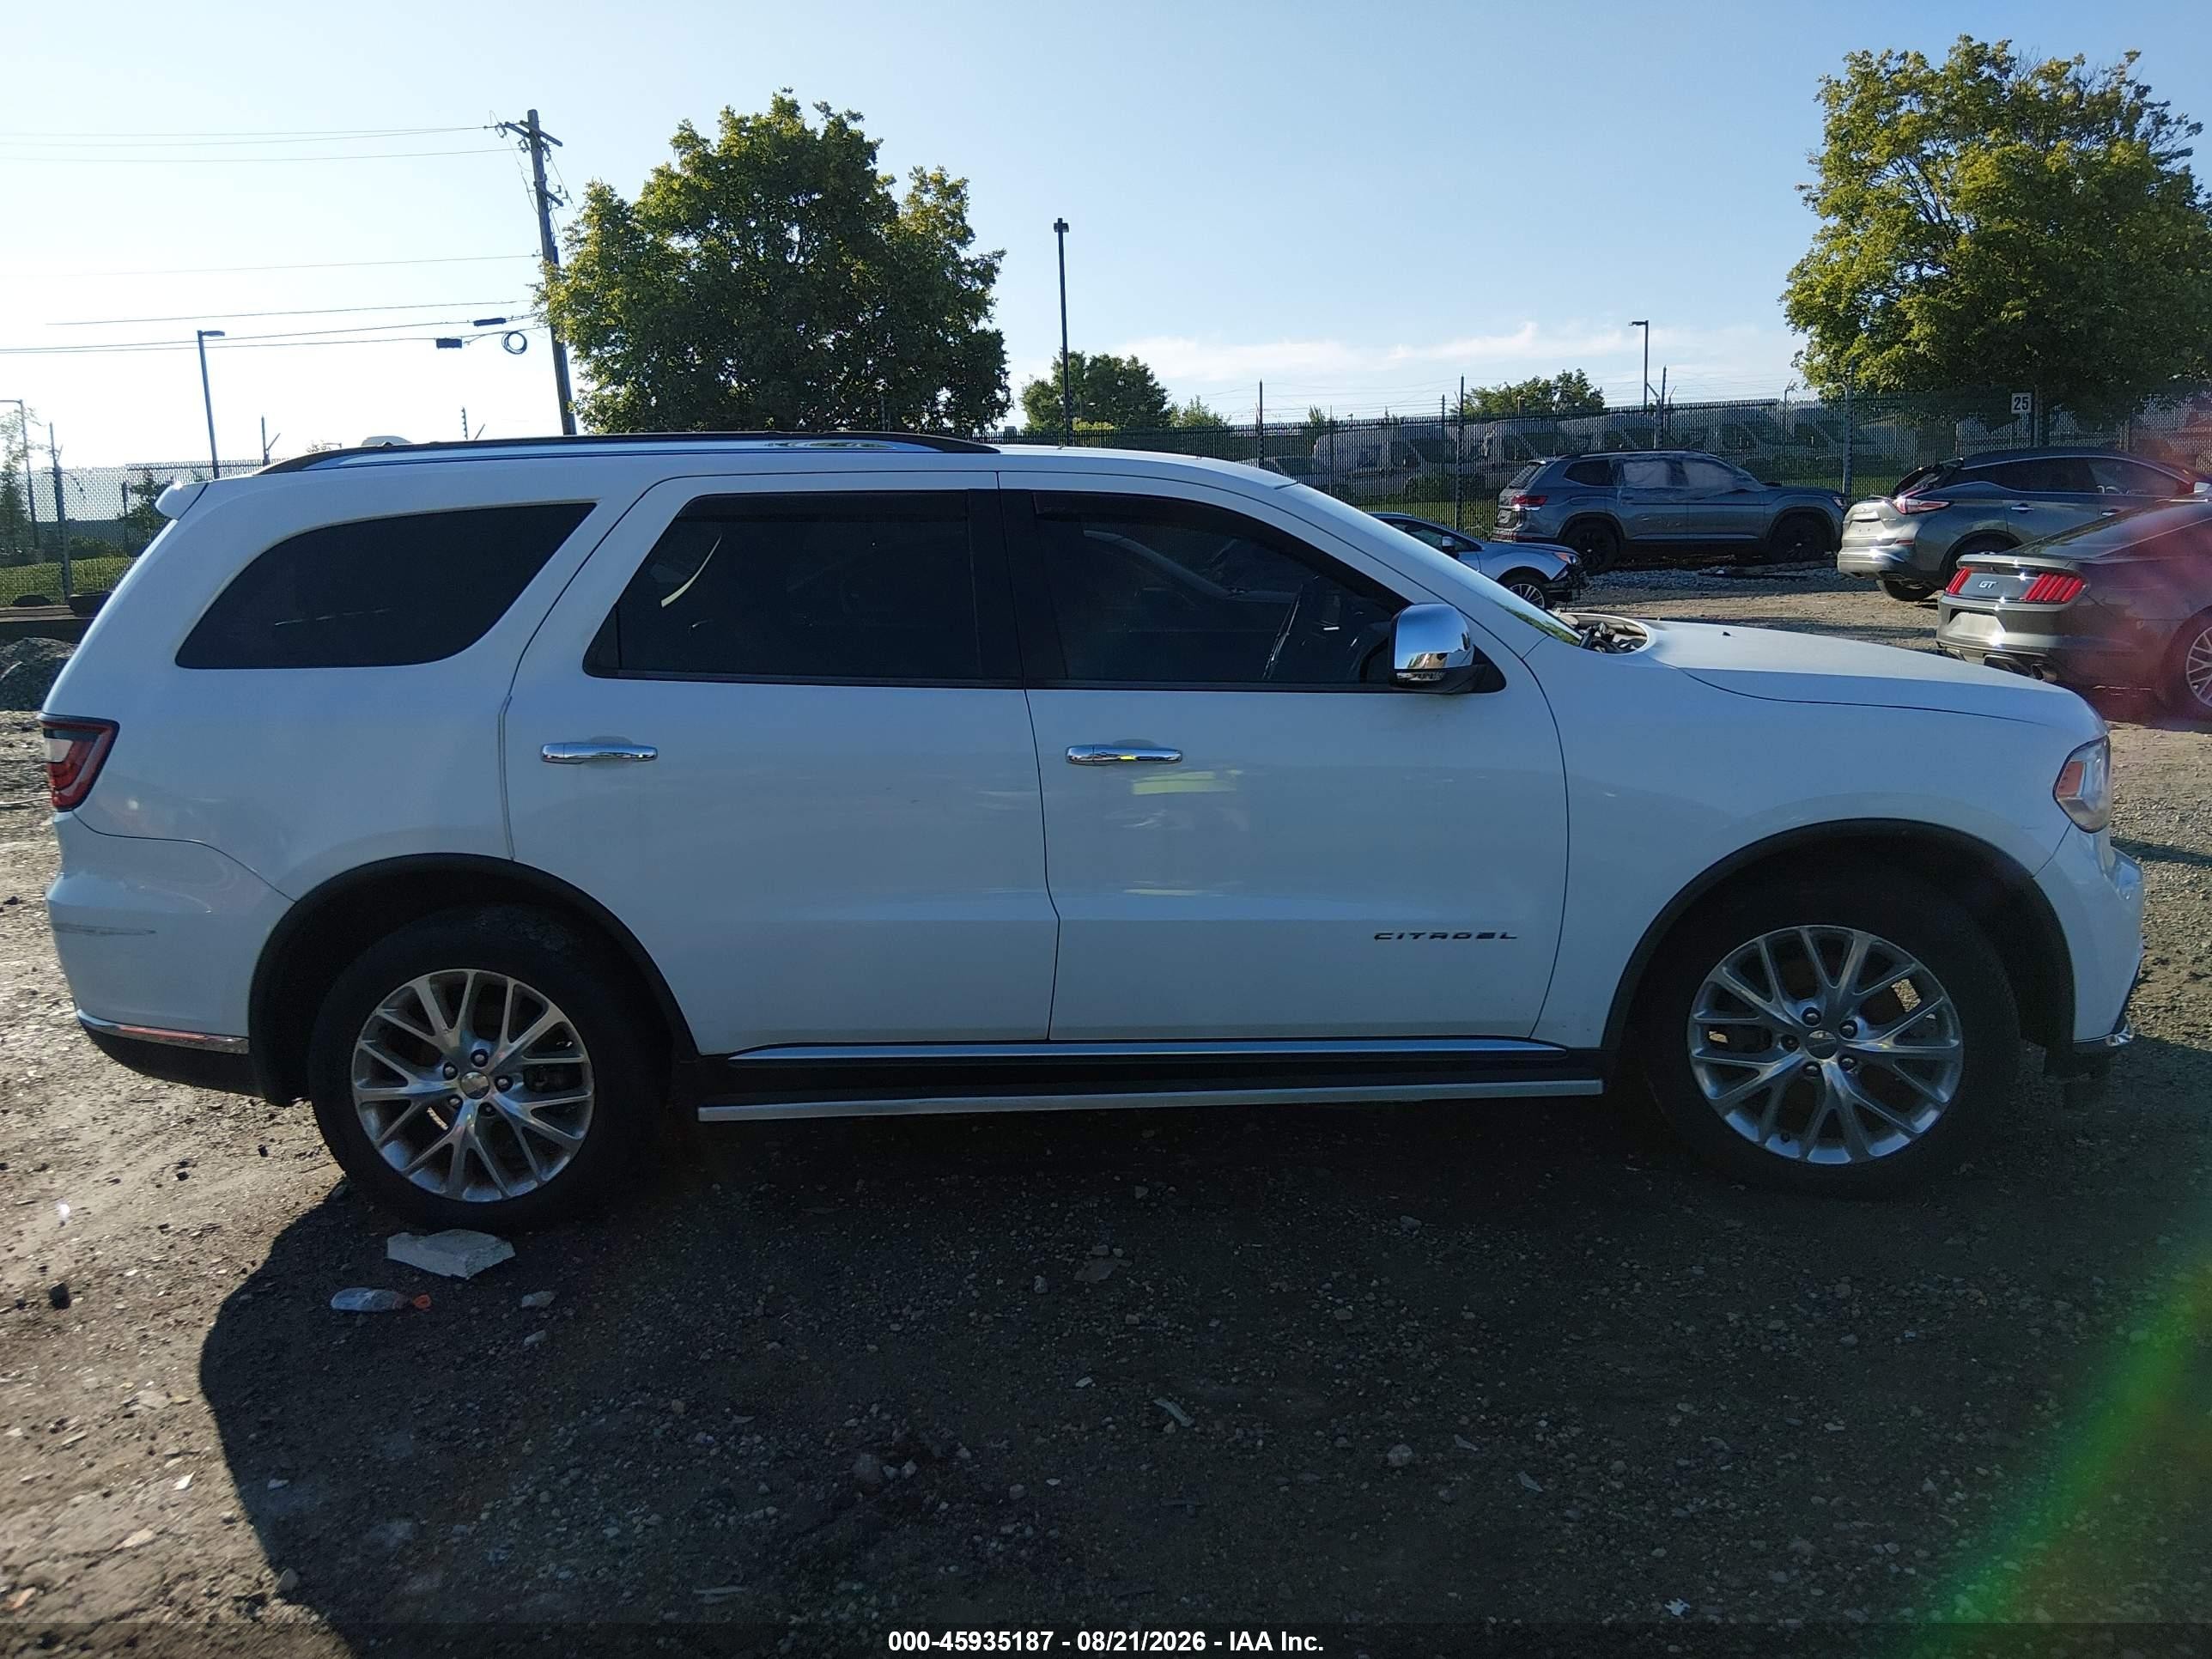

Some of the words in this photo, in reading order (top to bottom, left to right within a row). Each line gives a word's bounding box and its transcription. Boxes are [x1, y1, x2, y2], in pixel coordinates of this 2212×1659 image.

[2014, 396, 2029, 410] 25
[1978, 580, 1998, 589] GT
[1373, 932, 1518, 941] CITADEL
